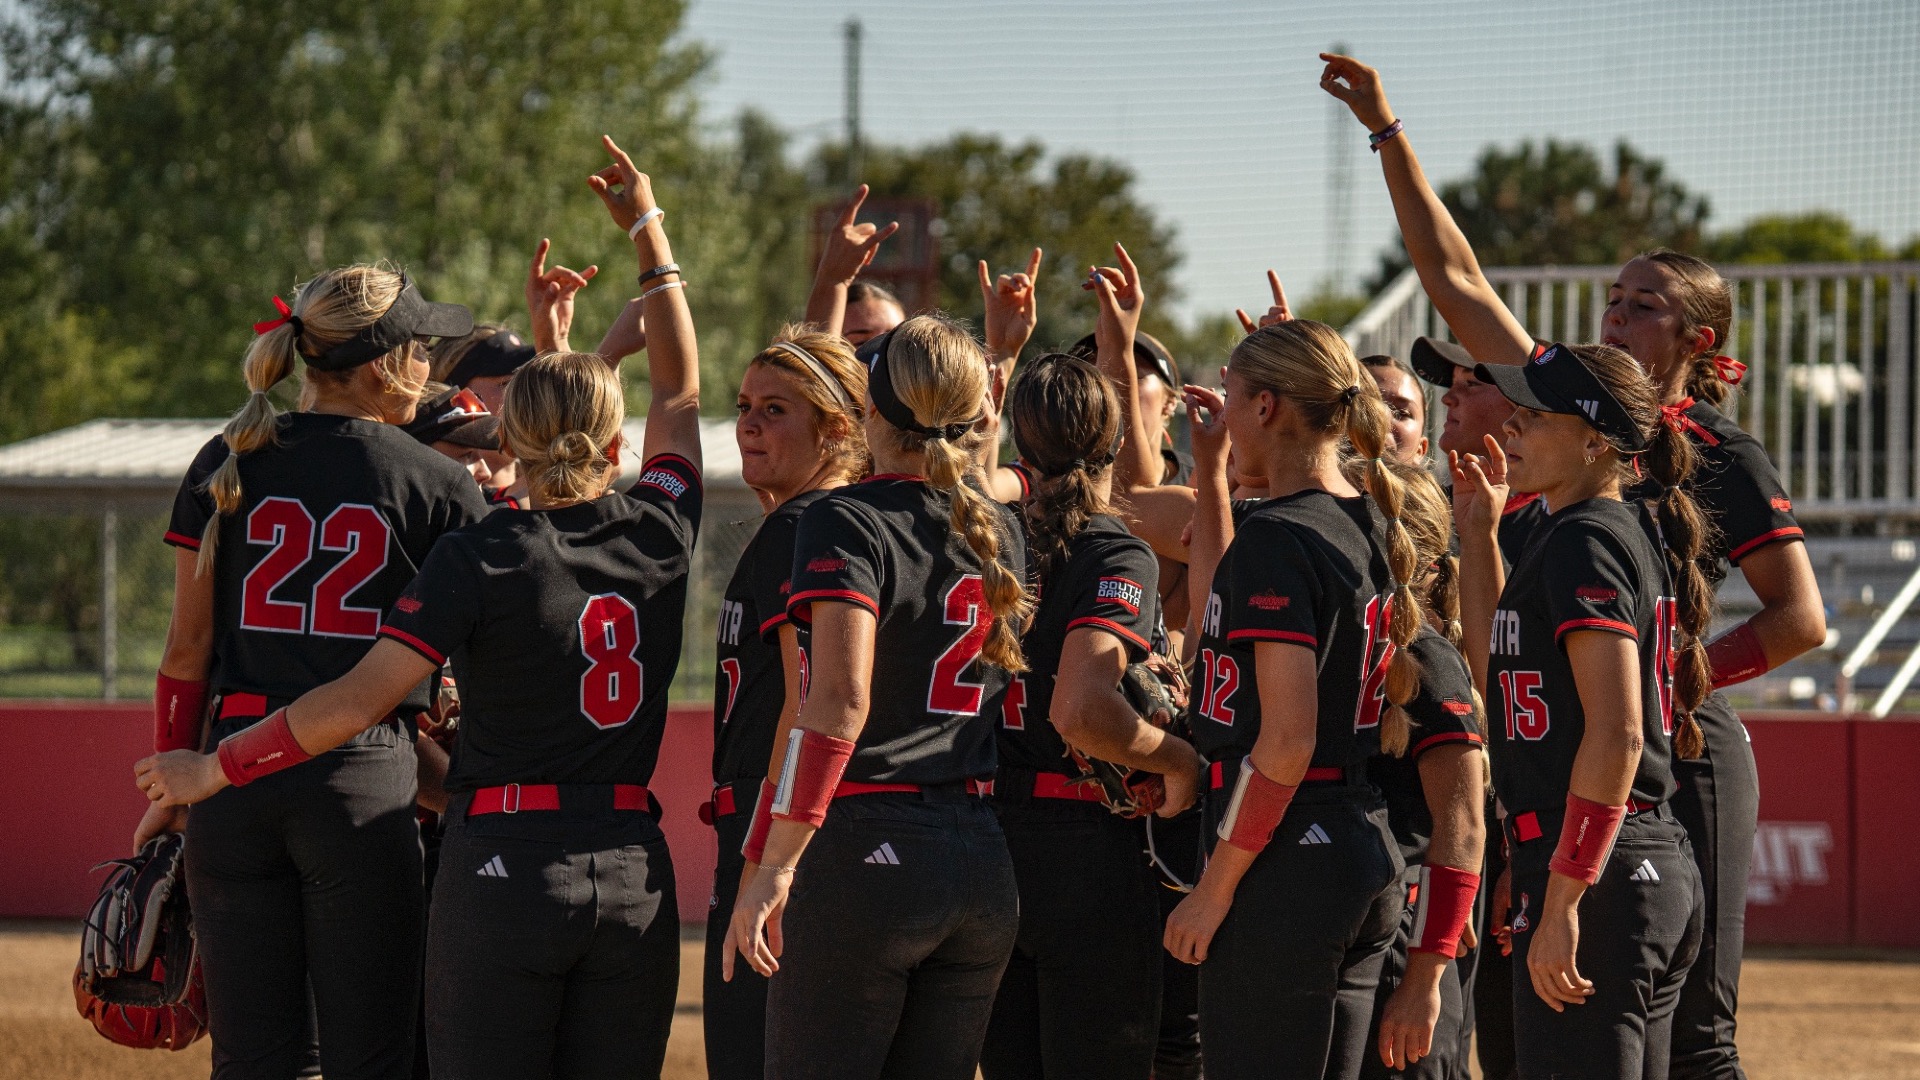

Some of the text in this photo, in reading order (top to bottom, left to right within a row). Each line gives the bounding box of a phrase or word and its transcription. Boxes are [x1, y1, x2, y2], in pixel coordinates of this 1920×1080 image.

[640, 474, 682, 497] SOUTH
[240, 496, 391, 640] 22
[1097, 589, 1140, 607] DAKOTA
[1099, 580, 1142, 599] SOUTH
[578, 591, 643, 730] 8
[926, 573, 995, 716] 2
[1199, 648, 1239, 727] 12
[1498, 670, 1550, 741] 15
